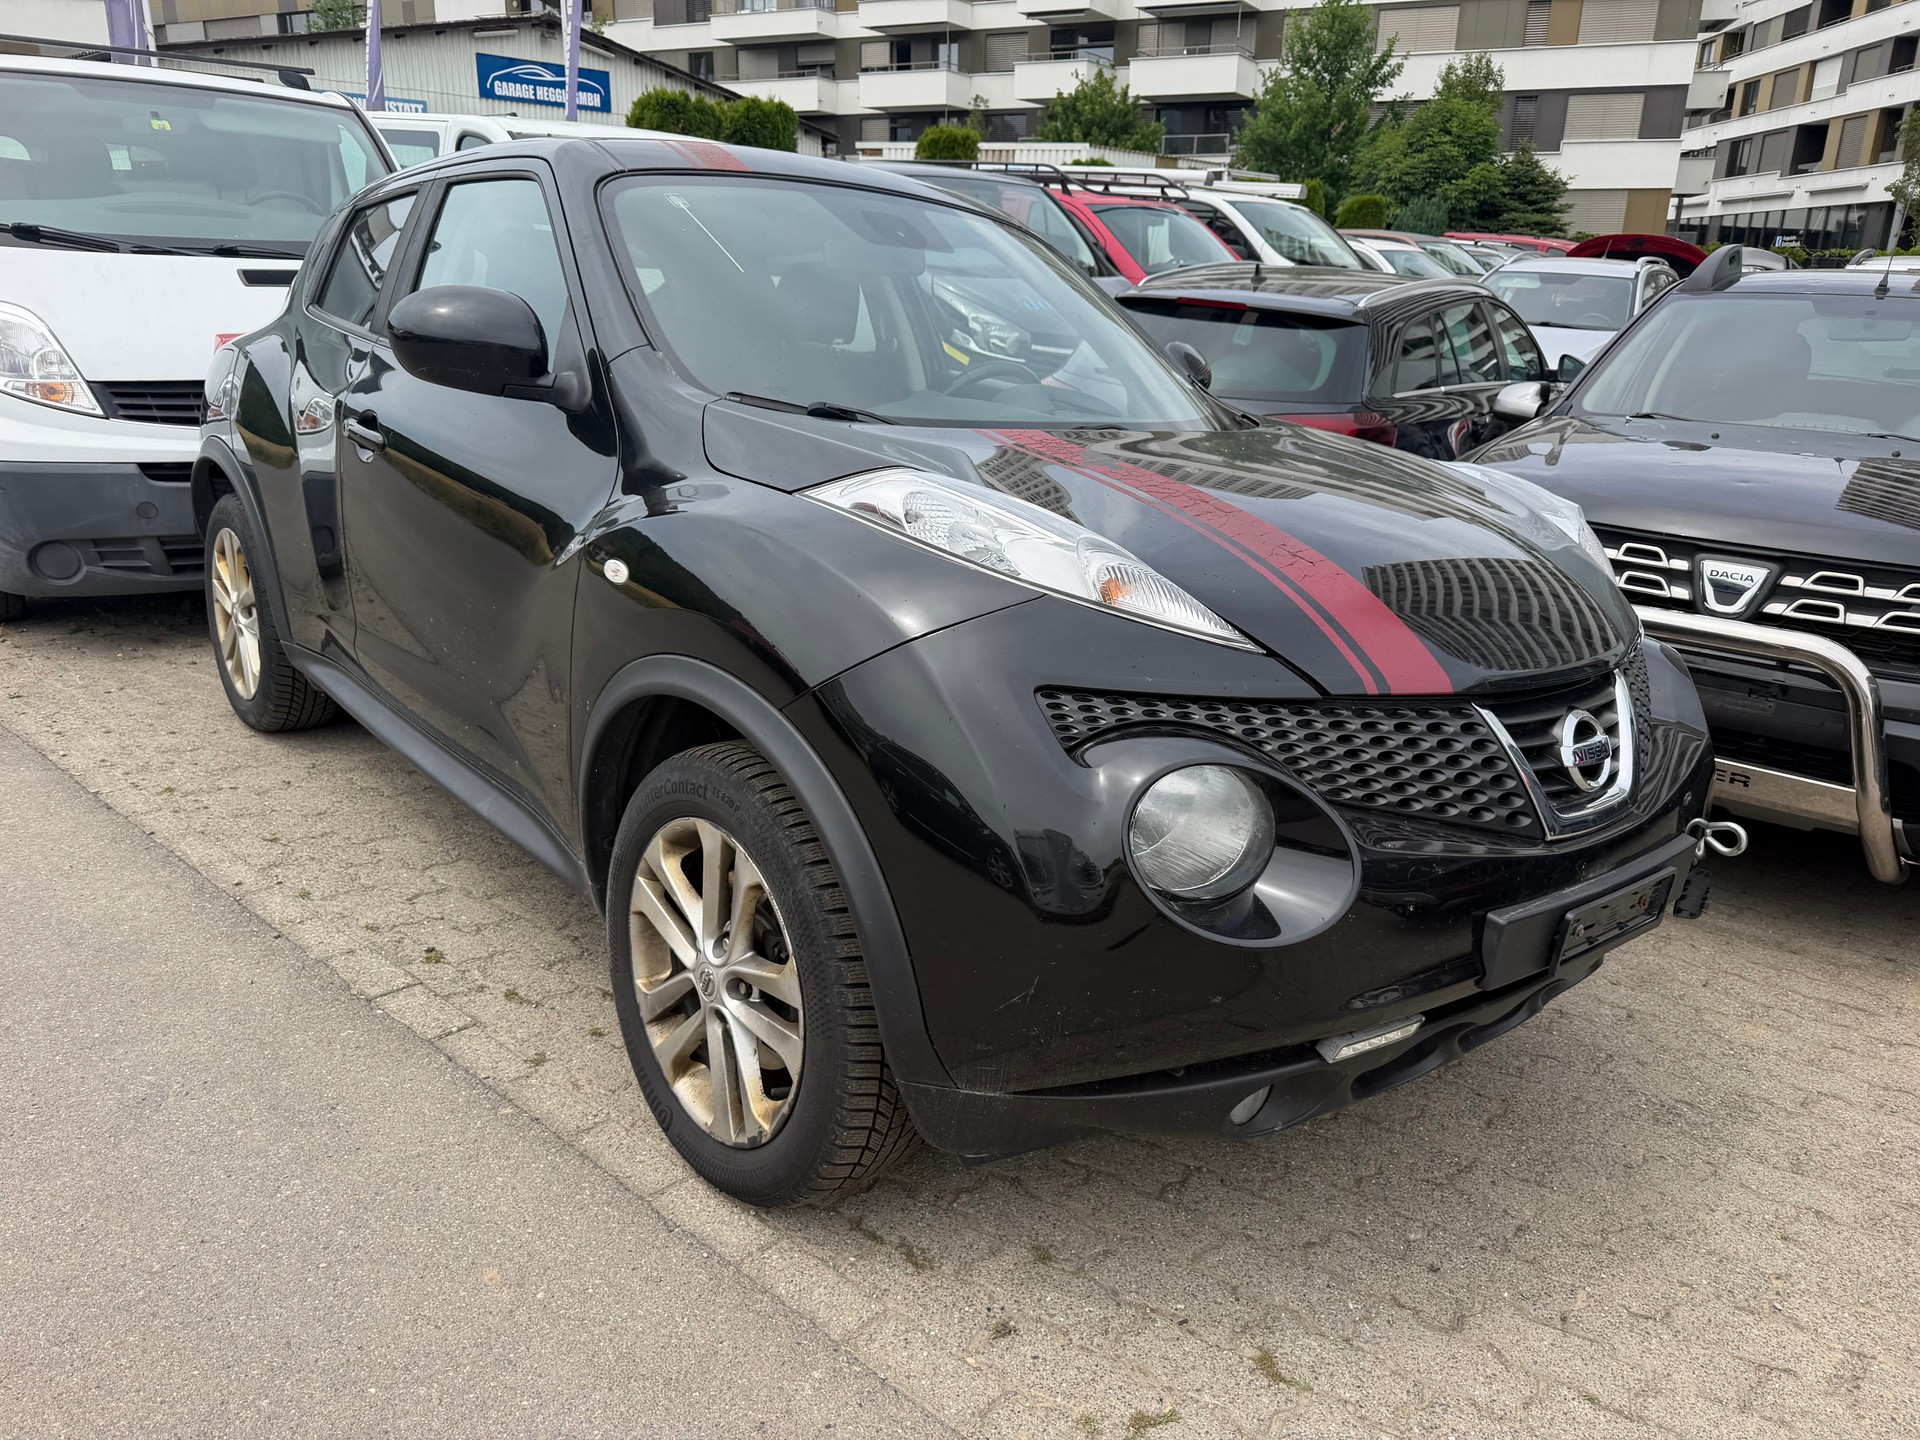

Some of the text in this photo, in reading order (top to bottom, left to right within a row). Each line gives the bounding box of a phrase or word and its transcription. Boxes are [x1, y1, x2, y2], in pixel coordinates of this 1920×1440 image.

[494, 80, 535, 100] GARAGE
[536, 85, 568, 103] HEGGL
[1709, 569, 1755, 583] DACIA
[1572, 742, 1610, 763] NISSA
[1715, 768, 1751, 788] ER
[635, 778, 741, 816] WinterContact TS 870 P
